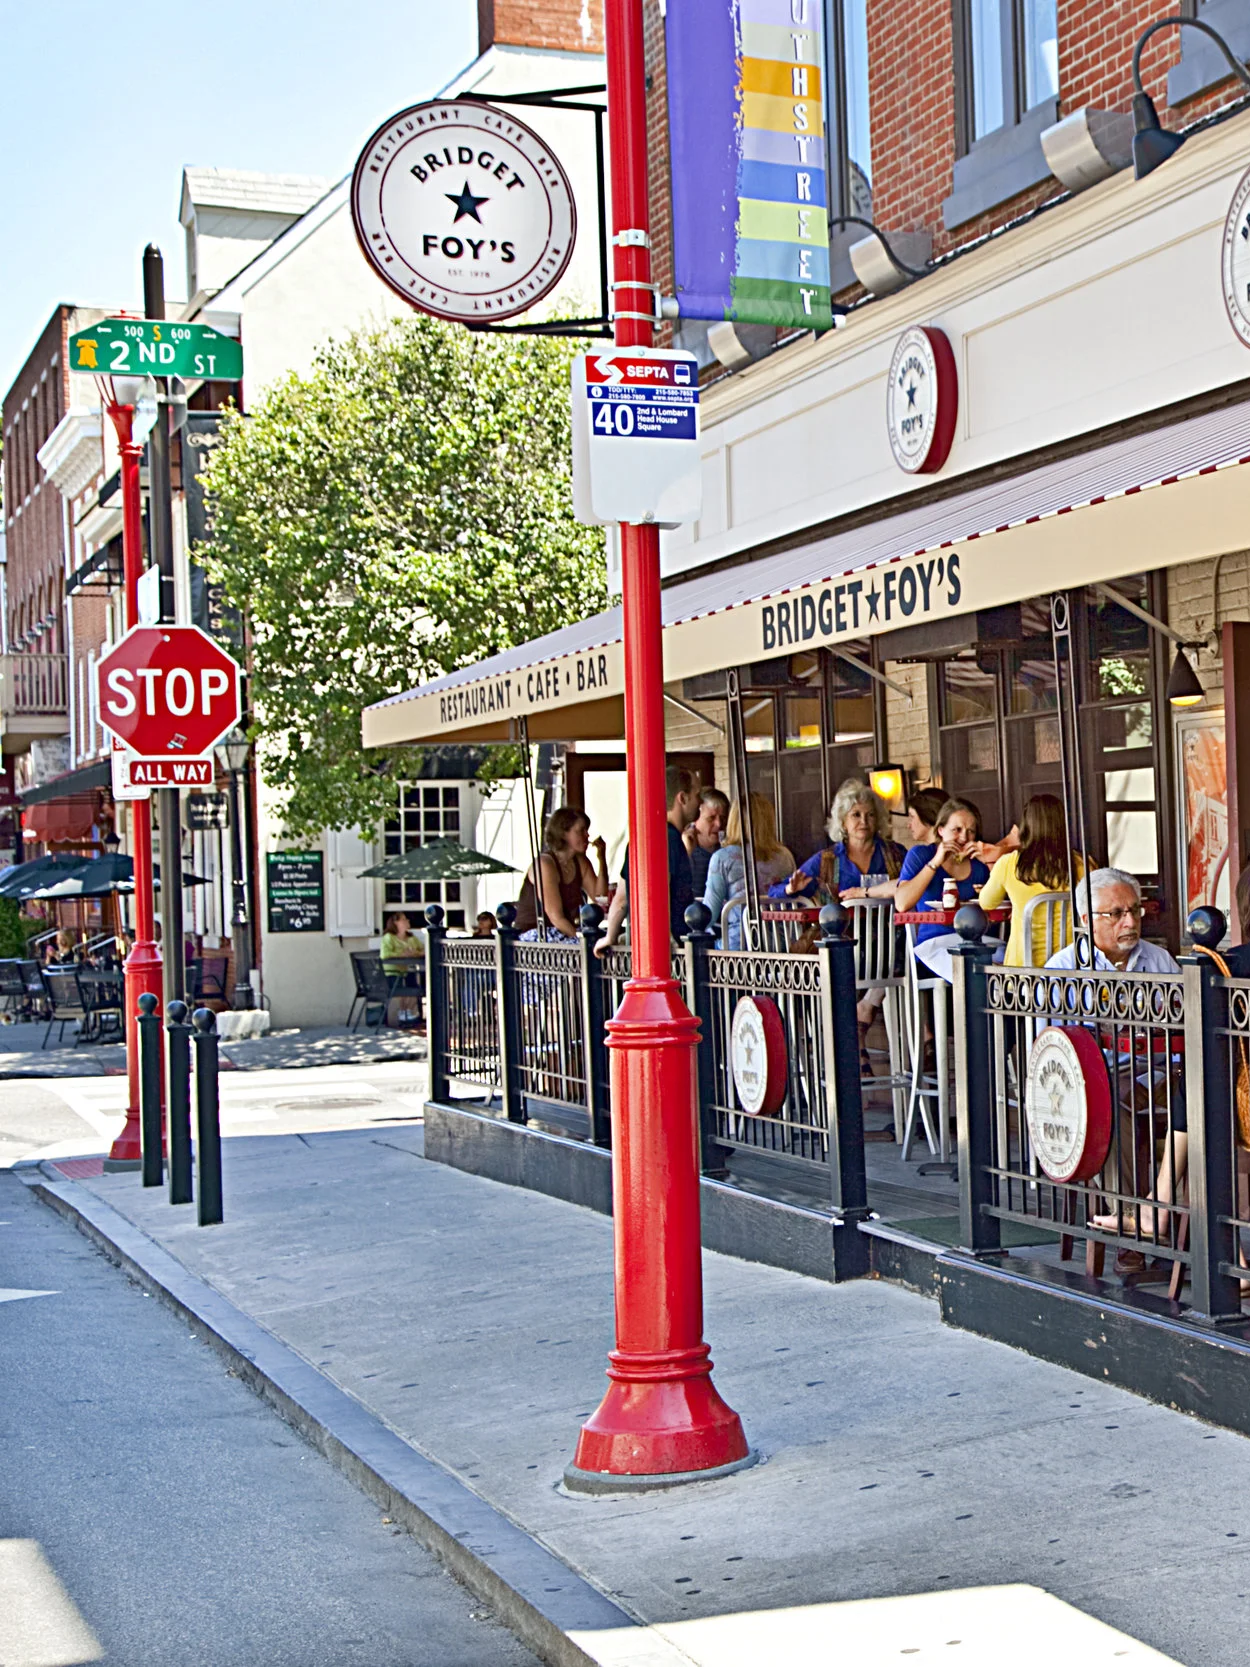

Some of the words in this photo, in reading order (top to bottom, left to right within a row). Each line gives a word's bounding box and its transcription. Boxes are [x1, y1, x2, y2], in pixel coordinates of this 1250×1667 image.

[370, 109, 461, 174] RESTAURANT
[483, 115, 524, 143] CAFE
[537, 157, 559, 188] BAR
[409, 146, 526, 192] BRIDGET
[371, 232, 394, 264] BAR
[422, 234, 516, 263] FOY'S
[407, 278, 449, 305] CAFE
[472, 247, 561, 311] RESTAURANT
[124, 325, 144, 337] 500
[152, 325, 162, 342] S
[170, 327, 191, 340] 600
[194, 354, 216, 375] ST
[626, 365, 669, 379] SEPTA
[595, 403, 634, 436] 40
[637, 407, 650, 415] 2nd
[658, 408, 688, 417] Lombard
[637, 415, 655, 423] Head
[656, 415, 678, 424] House
[901, 413, 924, 437] FOY'S
[637, 423, 662, 432] Square
[762, 580, 863, 650] BRIDGET
[884, 553, 961, 621] FOY'S
[106, 667, 230, 717] STOP
[440, 679, 512, 724] RESTAURANT
[527, 666, 559, 702] CAFE
[577, 654, 608, 692] BAR
[134, 764, 167, 782] ALL
[173, 764, 208, 781] WAY
[1043, 1122, 1070, 1143] FOY'S
